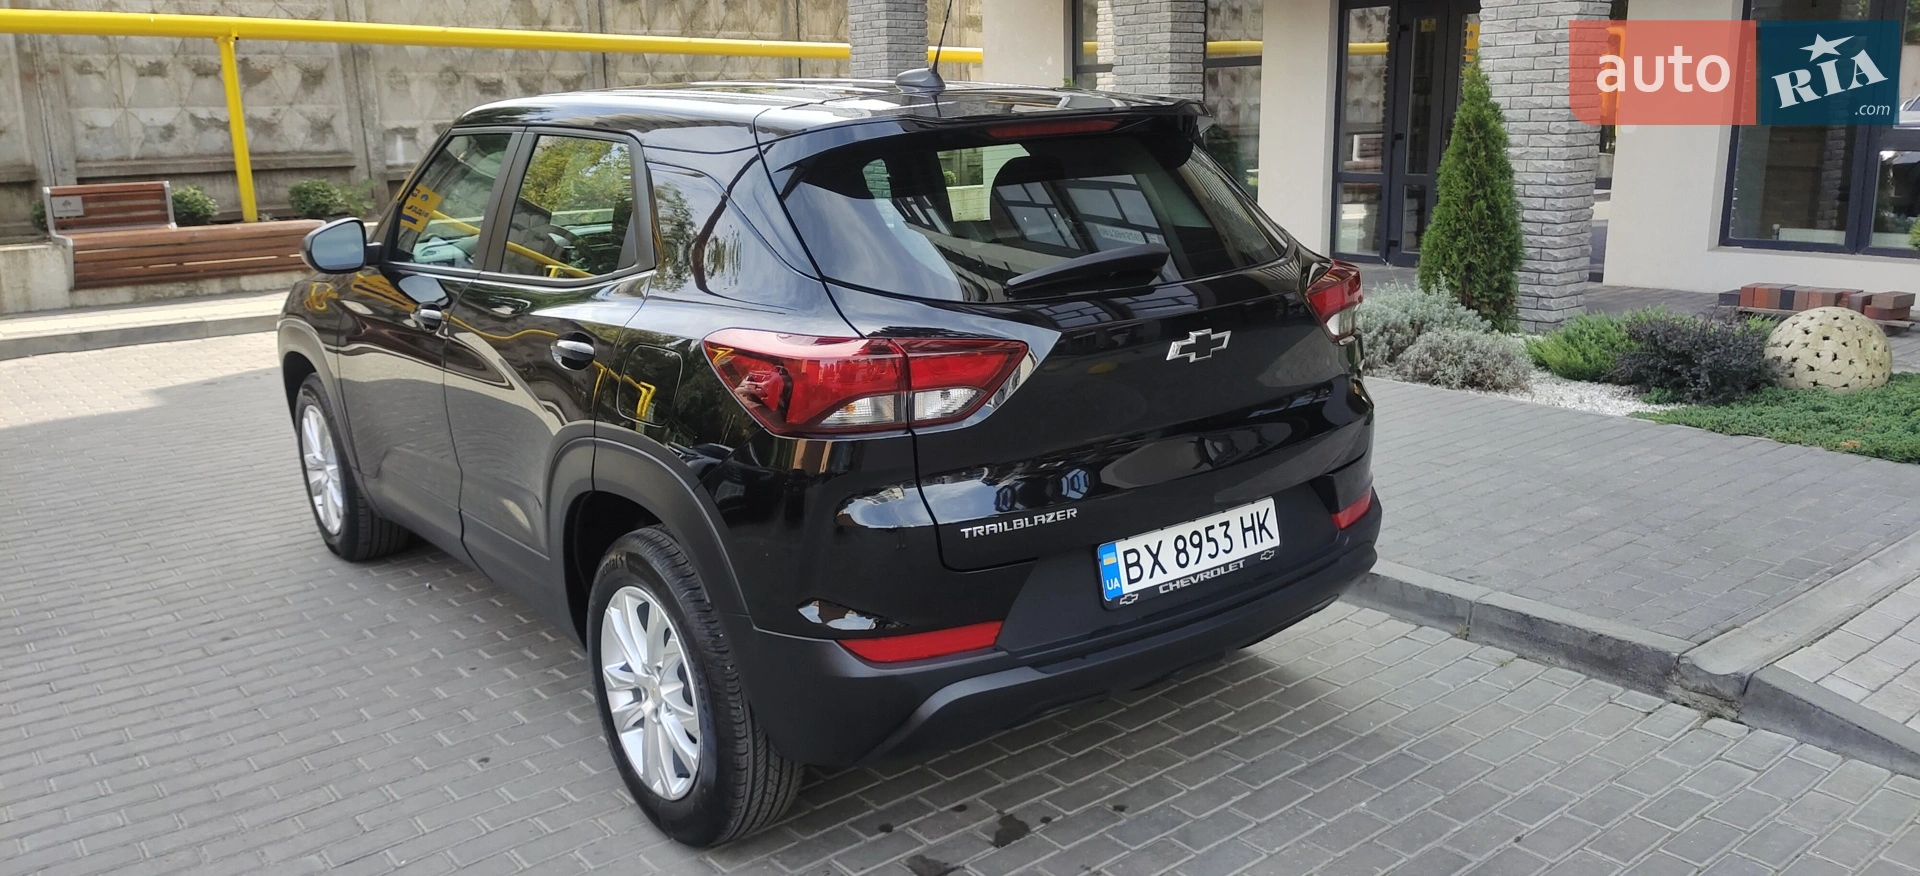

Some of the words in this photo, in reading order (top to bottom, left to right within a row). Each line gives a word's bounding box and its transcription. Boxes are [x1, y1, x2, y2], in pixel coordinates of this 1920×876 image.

[960, 507, 1078, 539] TRAILBLAZER
[1122, 540, 1168, 586] BX
[1173, 520, 1234, 569] 8953
[1239, 507, 1274, 549] HK
[1106, 577, 1121, 591] UA
[1158, 558, 1246, 595] CHEVROLET
